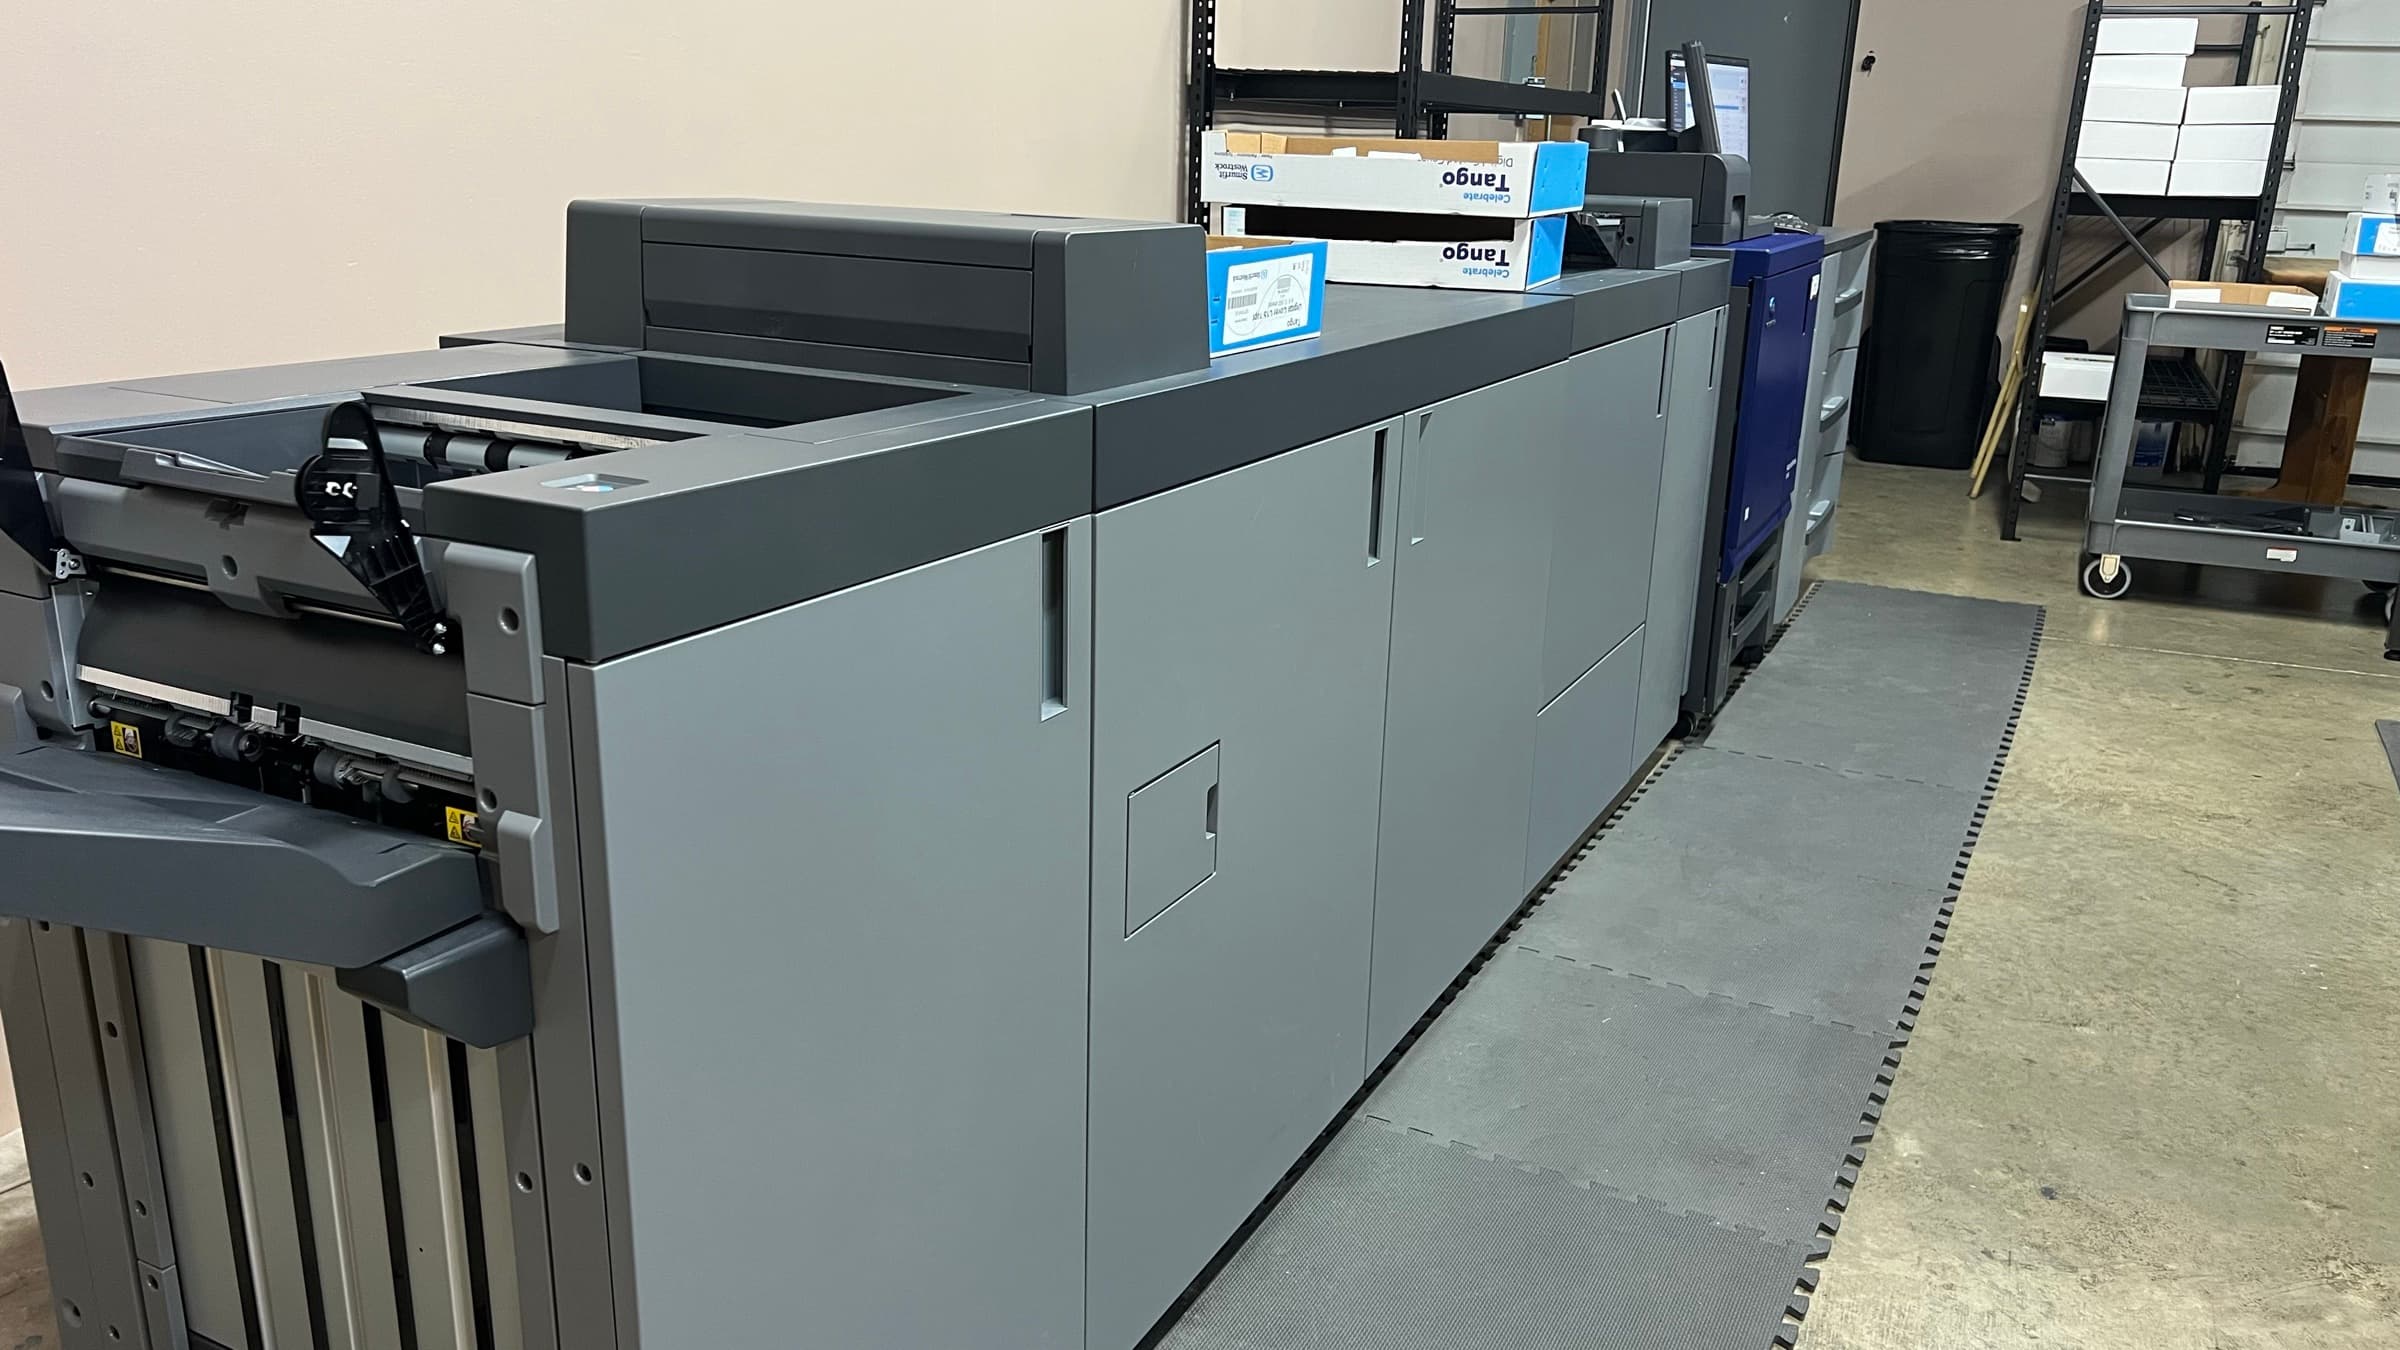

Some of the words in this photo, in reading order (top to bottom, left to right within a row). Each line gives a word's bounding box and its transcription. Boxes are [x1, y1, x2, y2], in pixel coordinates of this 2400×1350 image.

[1215, 163, 1248, 172] Westrock
[1219, 171, 1248, 180] Smurfit
[1442, 167, 1510, 192] Tango
[1463, 192, 1511, 203] Celebrate
[1442, 243, 1510, 267] Tango
[1463, 267, 1510, 278] Celebrate
